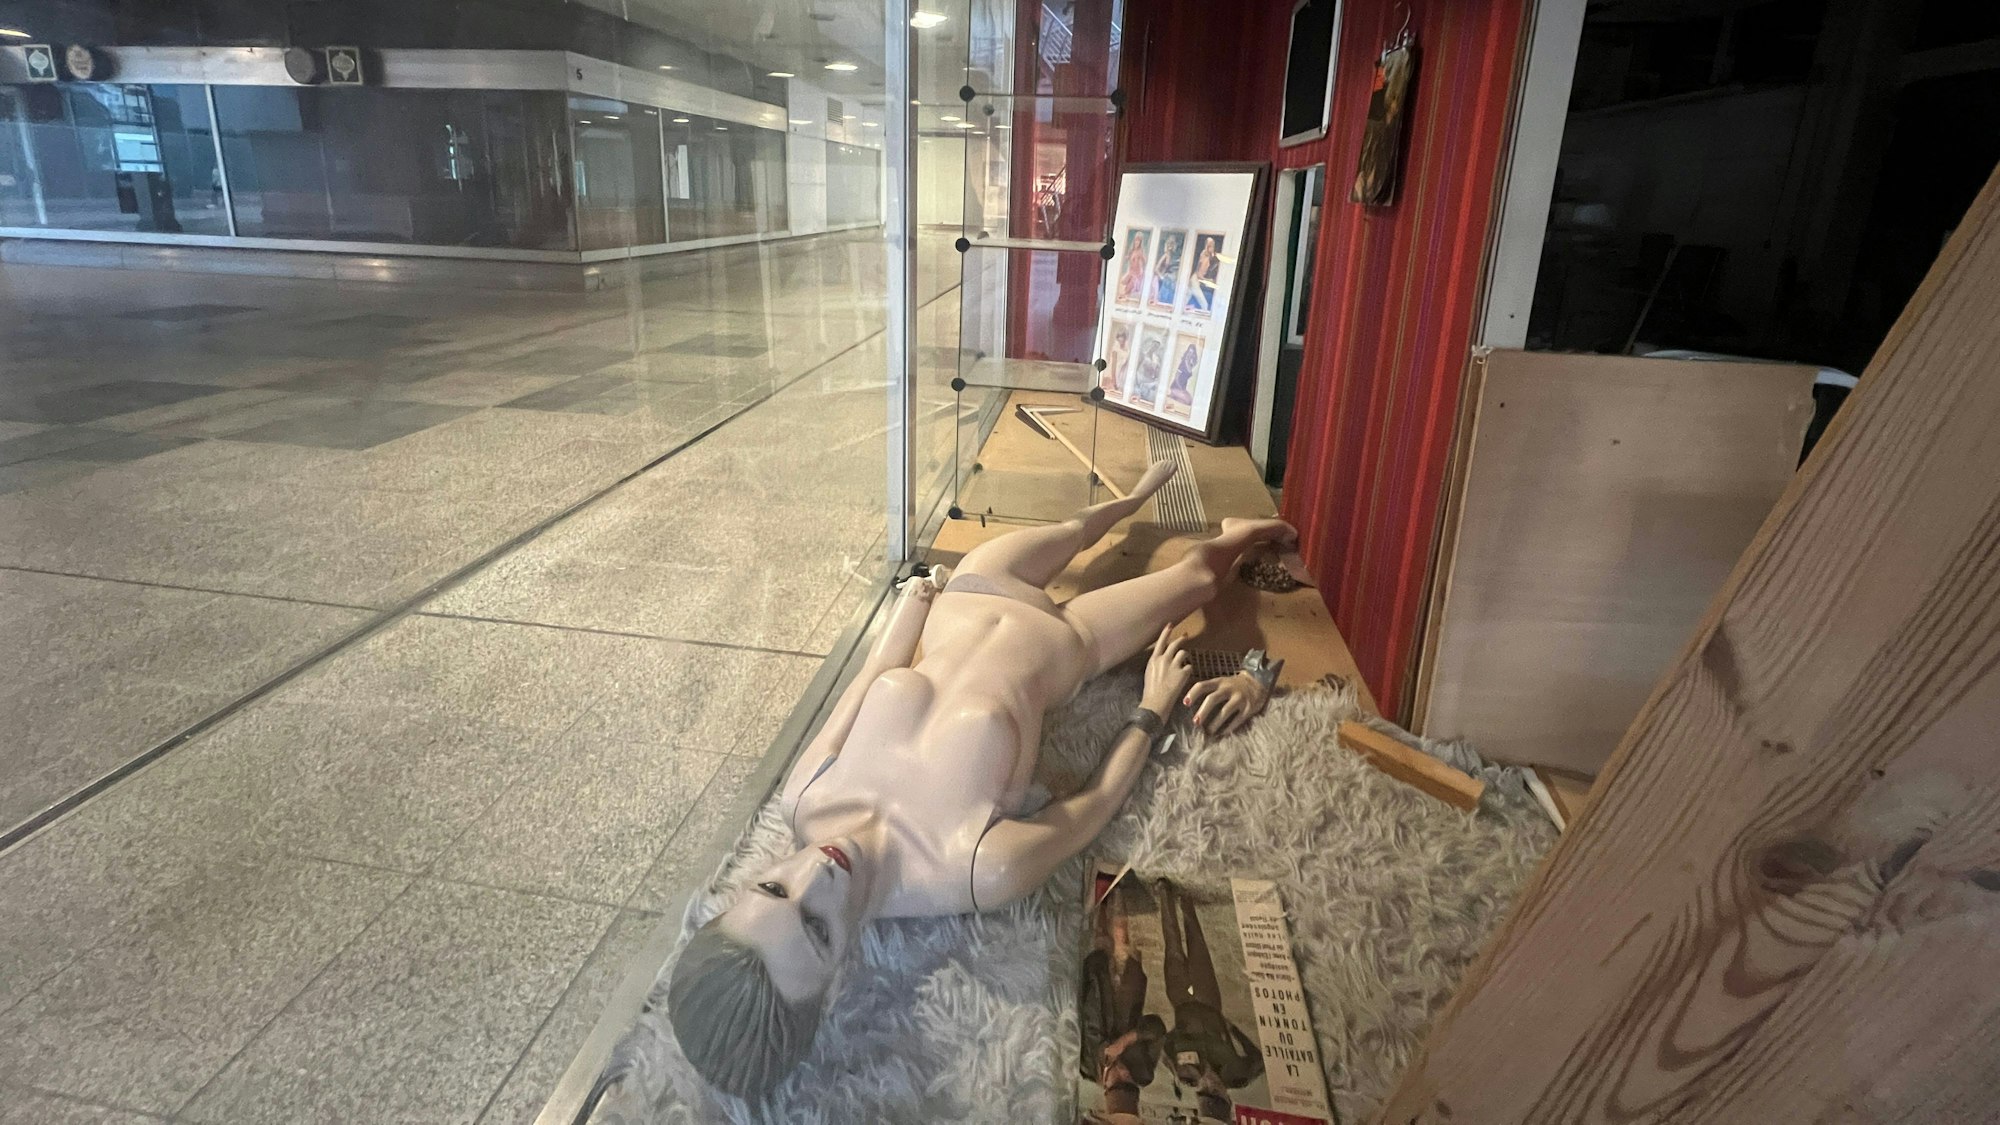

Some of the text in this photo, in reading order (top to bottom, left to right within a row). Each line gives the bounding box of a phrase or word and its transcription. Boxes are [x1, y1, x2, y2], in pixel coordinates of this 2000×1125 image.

[576, 68, 583, 81] 5
[1254, 987, 1301, 1002] PHOTOS
[1273, 1002, 1286, 1014] EN
[1259, 1015, 1307, 1031] TONKIN
[1279, 1032, 1294, 1046] DU
[1264, 1045, 1314, 1062] BATAILLE
[1286, 1064, 1299, 1077] LA
